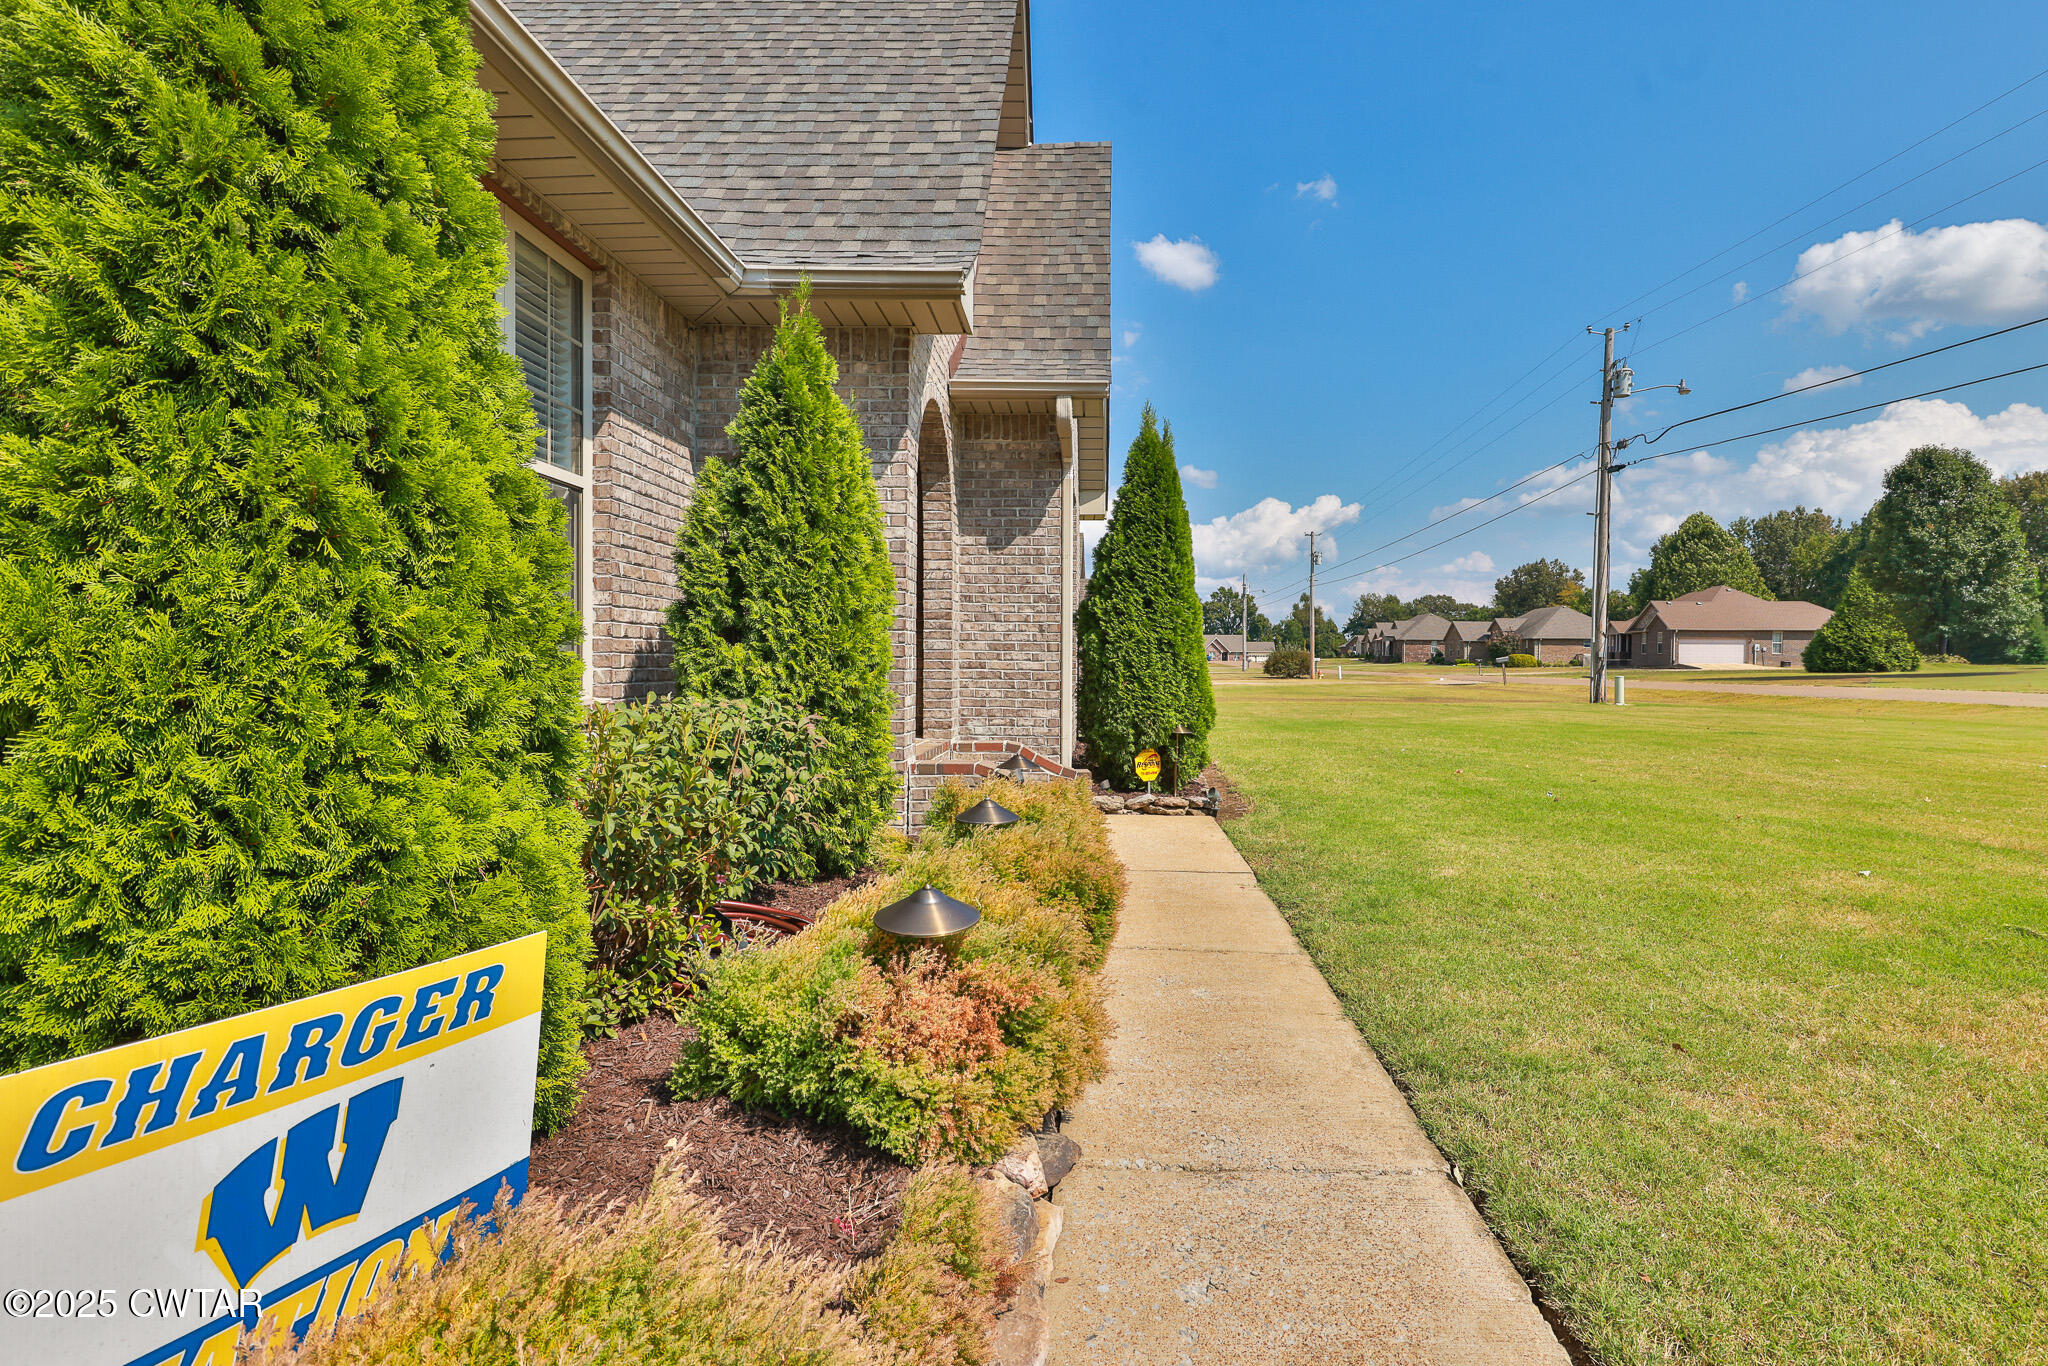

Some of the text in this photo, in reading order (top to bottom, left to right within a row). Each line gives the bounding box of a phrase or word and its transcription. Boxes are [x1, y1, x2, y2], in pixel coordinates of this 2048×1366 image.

[15, 964, 505, 1173] CHARGER
[152, 1206, 462, 1366] ATION
[195, 1076, 404, 1290] W
